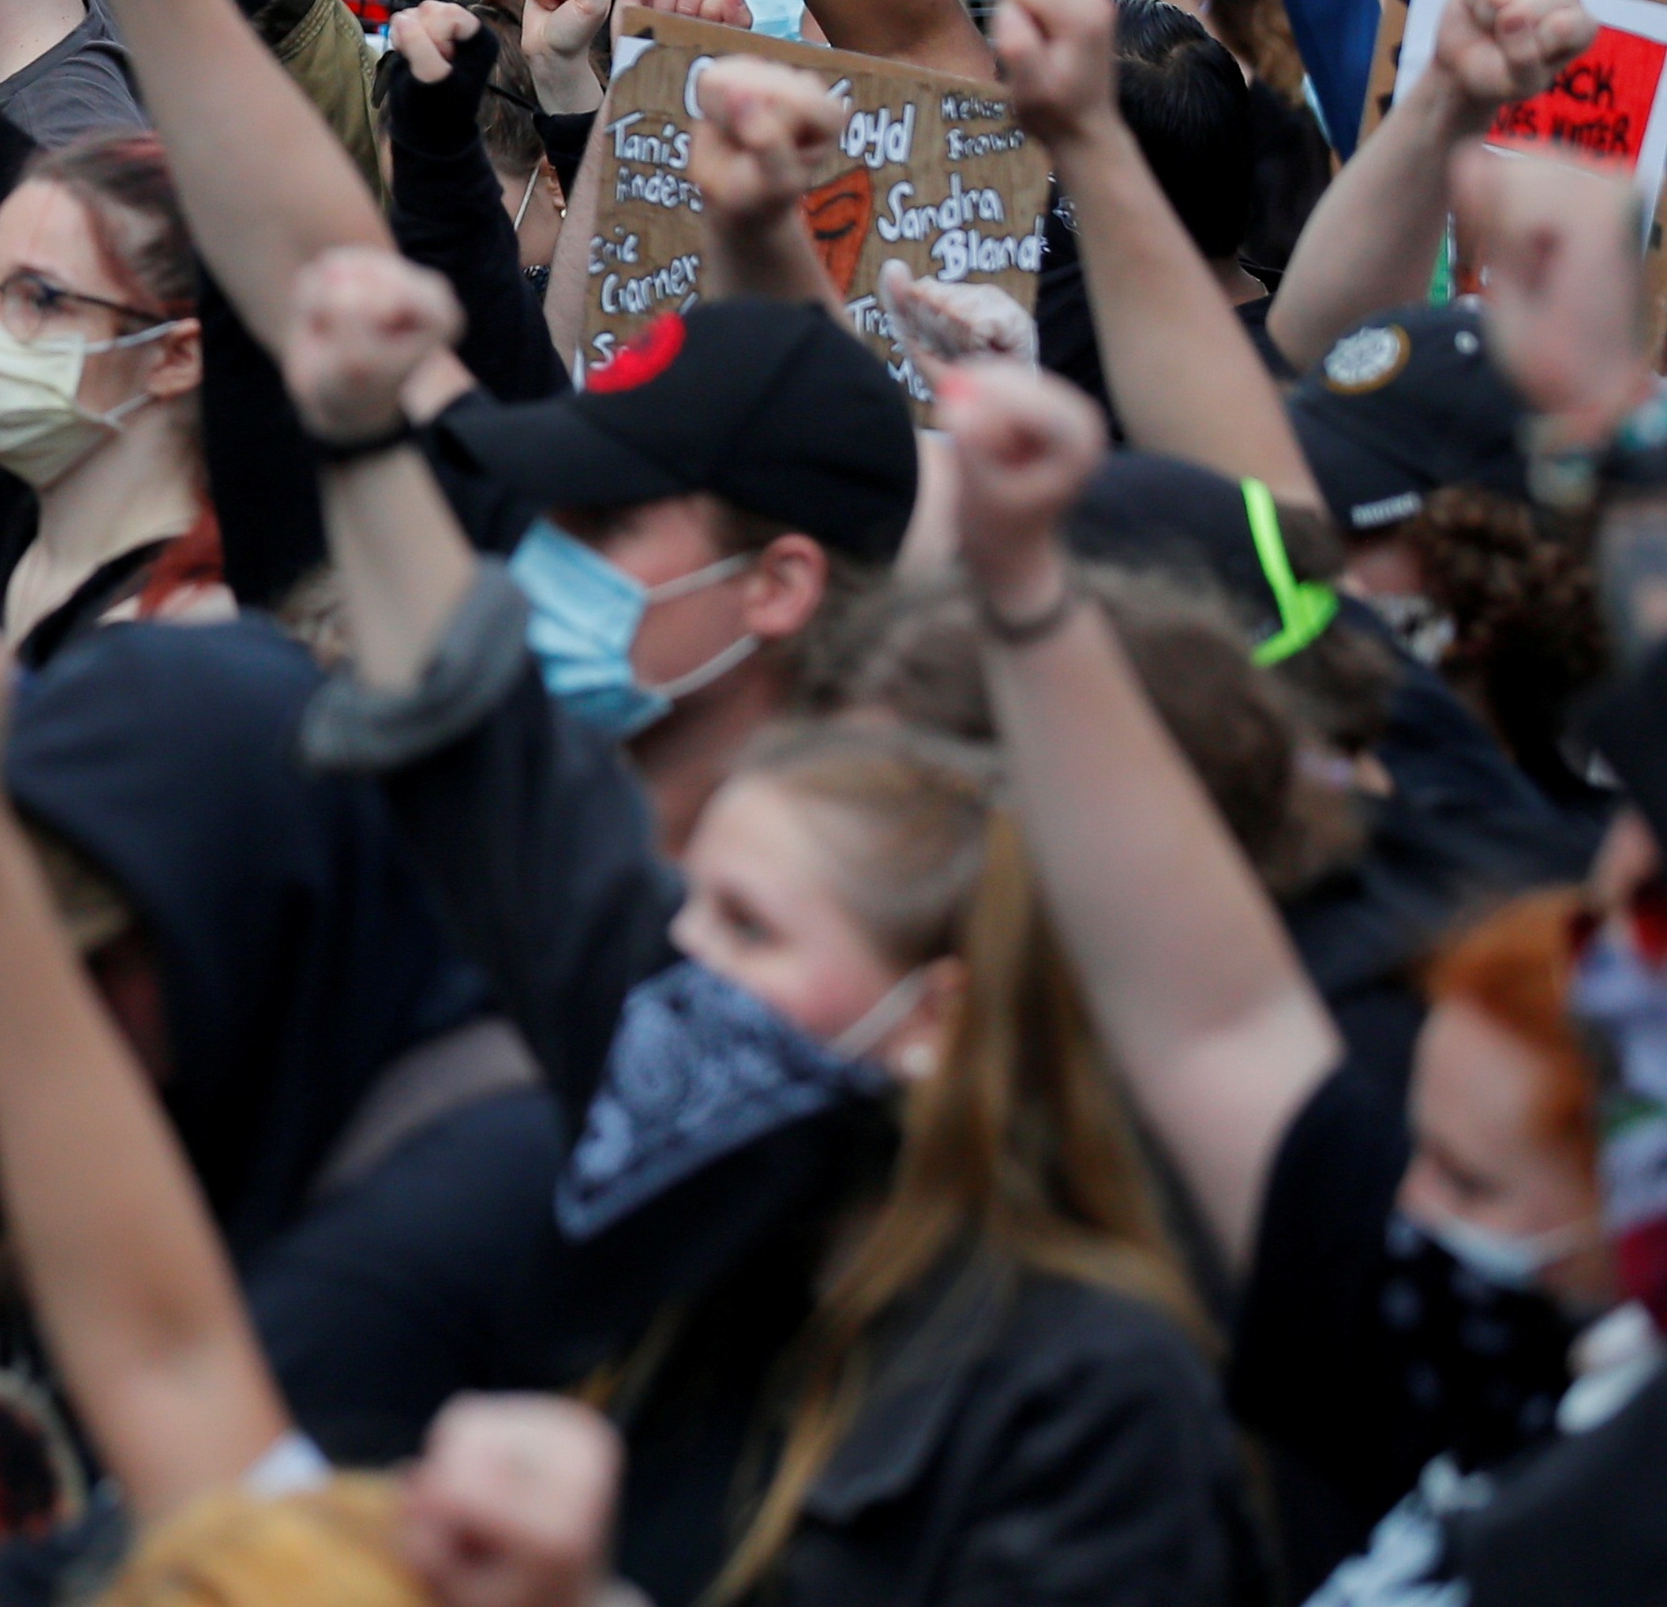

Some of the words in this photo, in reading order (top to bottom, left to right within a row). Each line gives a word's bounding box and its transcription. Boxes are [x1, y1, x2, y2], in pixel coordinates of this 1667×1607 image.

[877, 172, 1004, 242] Sandra
[931, 215, 1045, 282] Bland
[600, 254, 700, 314] Garner
